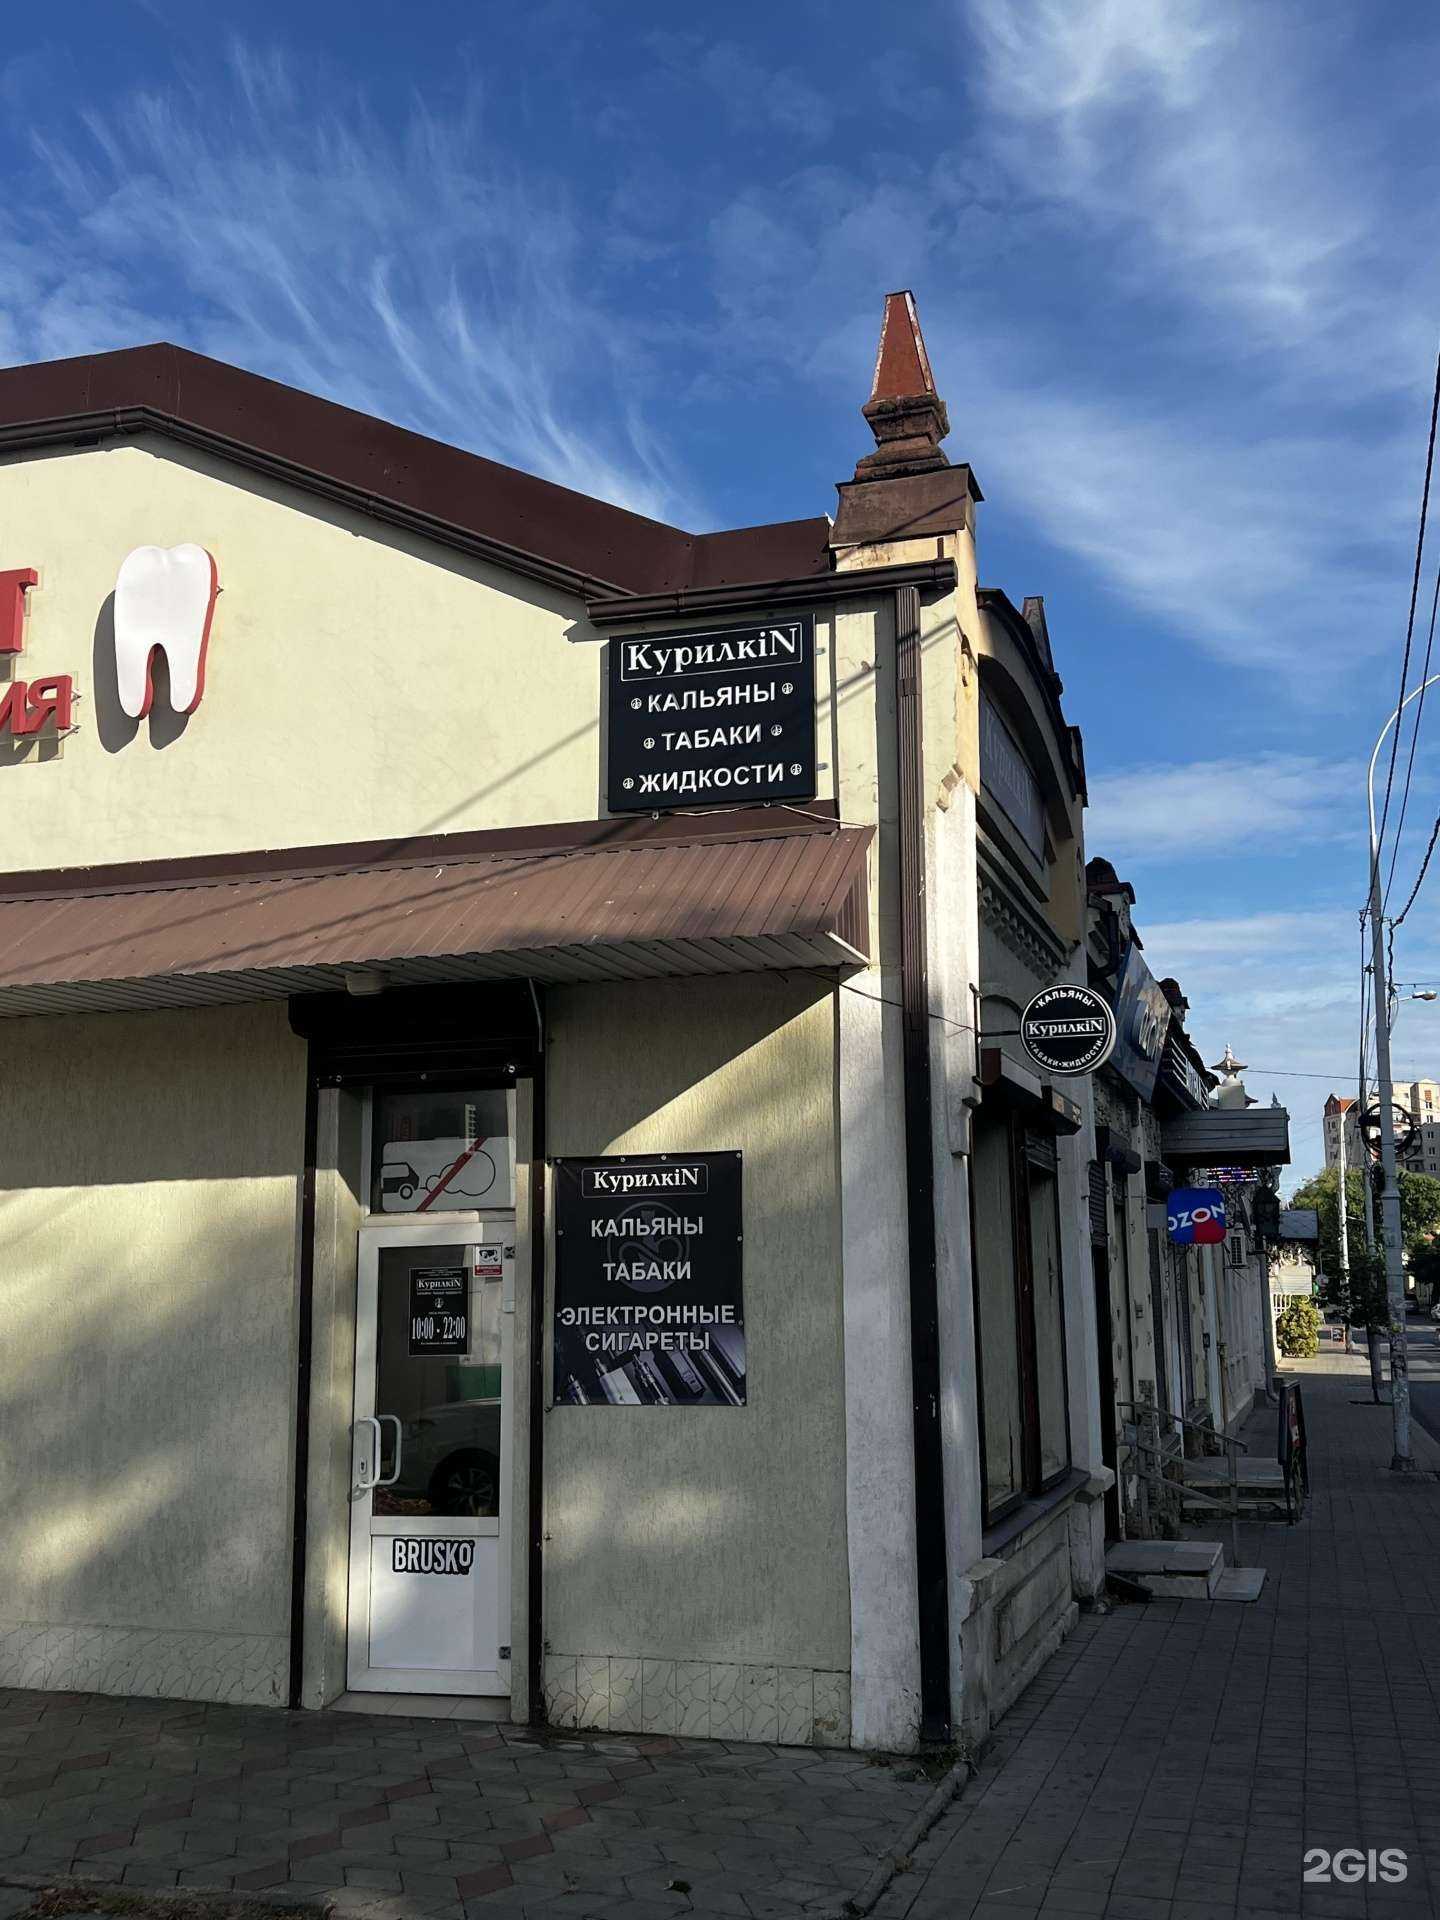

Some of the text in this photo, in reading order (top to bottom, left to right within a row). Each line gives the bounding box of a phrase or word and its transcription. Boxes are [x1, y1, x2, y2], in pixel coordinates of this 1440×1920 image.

[648, 682, 776, 713] КАЛЬЯНЫ
[661, 723, 762, 751] ТАБАКИ
[638, 763, 784, 793] ЖИДКОСТИ
[1037, 990, 1093, 1007] КАЛЬЯНЫ
[591, 1216, 704, 1237] КАЛЬЯНЫ
[1168, 1202, 1225, 1231] OZON
[602, 1261, 691, 1281] ТАБАКИ
[561, 1305, 735, 1326] ЭЛЕКТРОННЫЕ
[412, 1317, 434, 1339] 10:00
[443, 1316, 465, 1339] 22:00
[585, 1331, 710, 1351] СИГАРЕТЫ
[394, 1540, 473, 1573] BRUSKO
